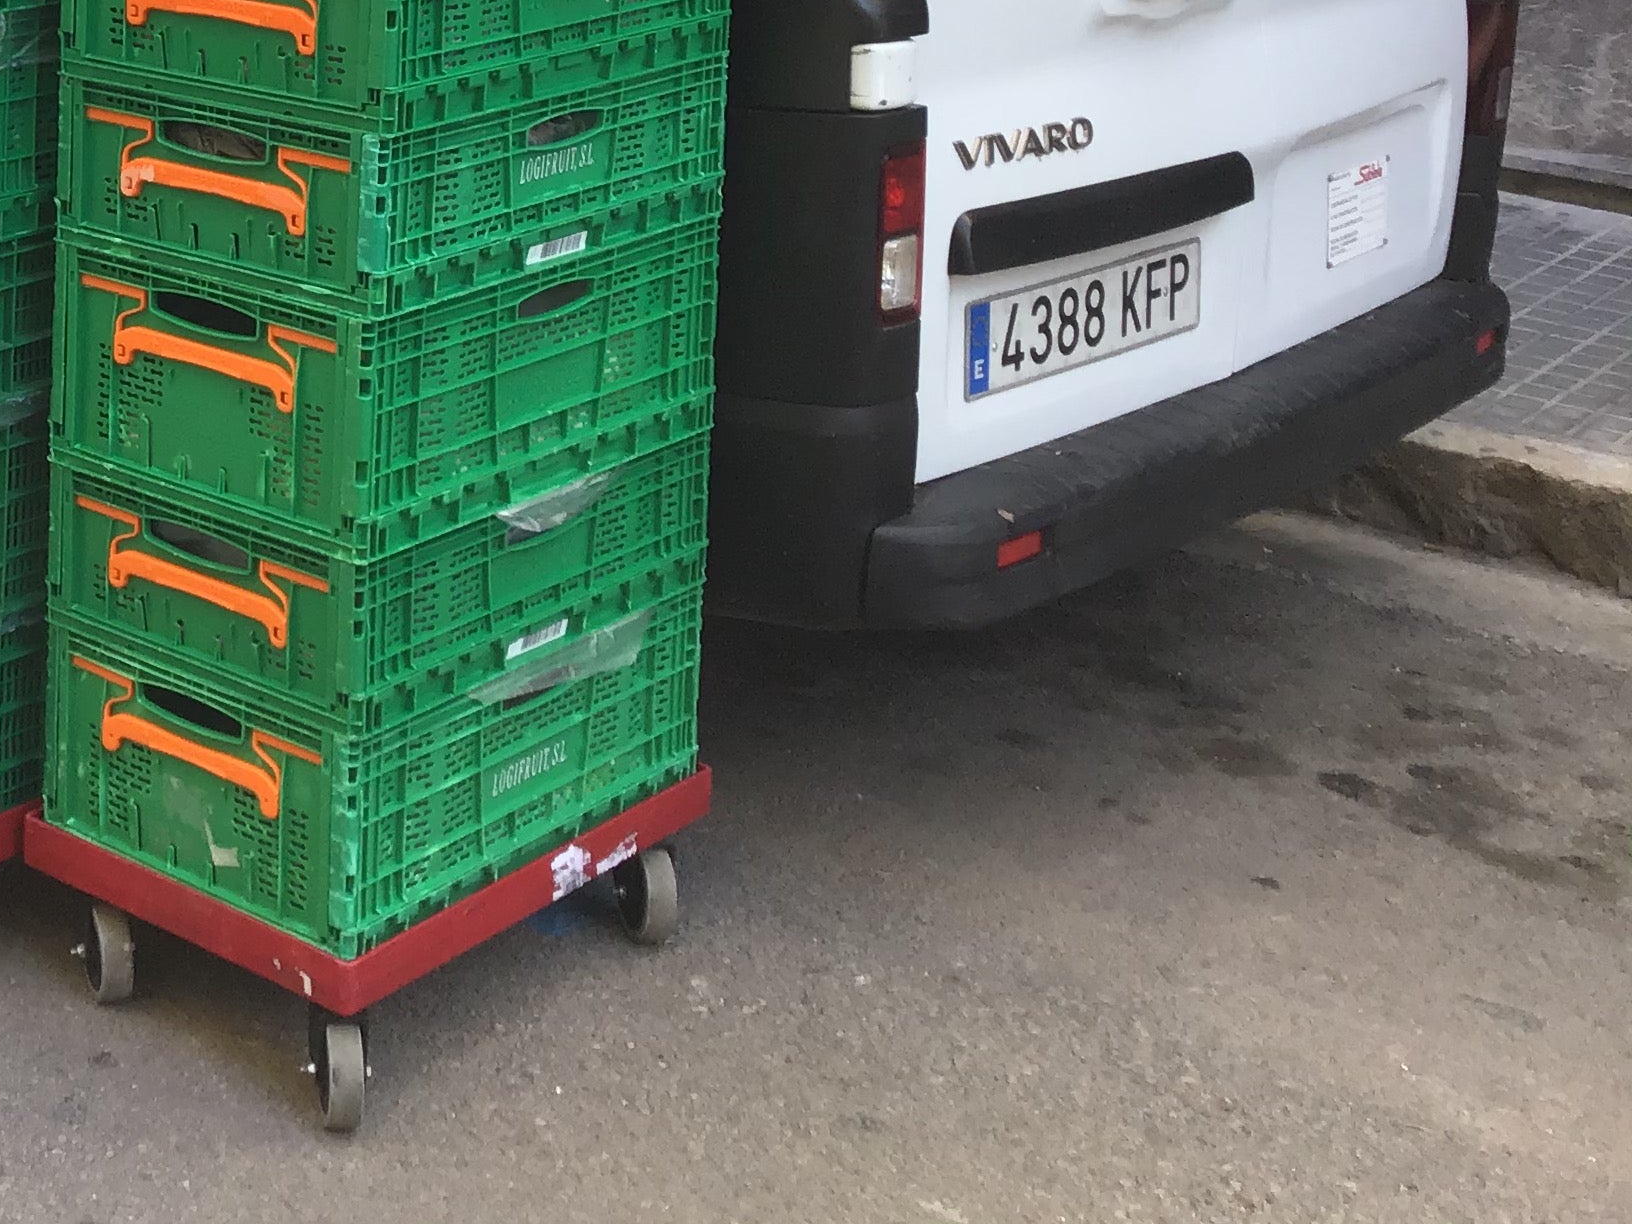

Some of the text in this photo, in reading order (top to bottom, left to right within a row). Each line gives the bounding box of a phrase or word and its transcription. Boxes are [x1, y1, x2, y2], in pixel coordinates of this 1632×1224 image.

[953, 117, 1094, 171] VIVARO
[1001, 253, 1190, 371] 4388 KFP
[974, 359, 984, 379] E
